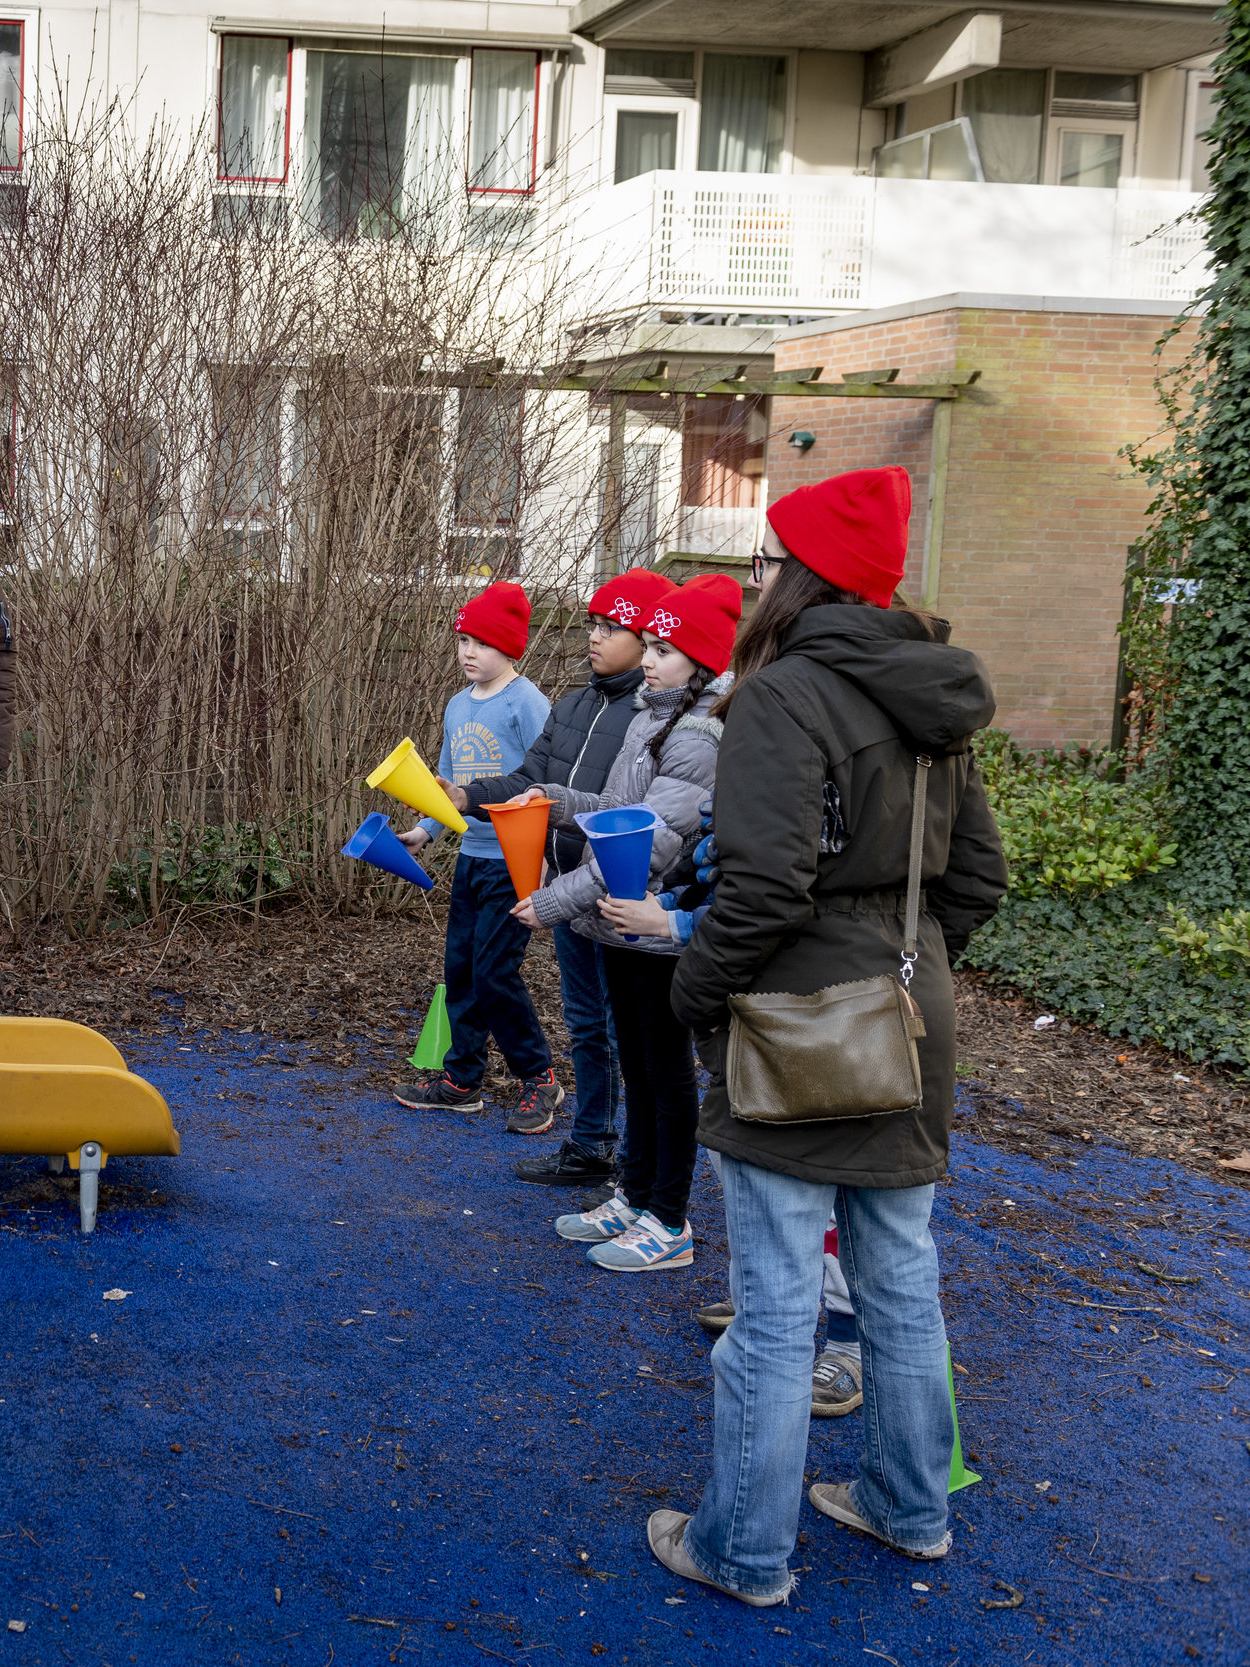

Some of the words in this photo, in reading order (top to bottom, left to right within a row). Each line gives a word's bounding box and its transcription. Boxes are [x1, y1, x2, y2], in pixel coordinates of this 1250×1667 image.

[464, 721, 503, 760] FLYWHEELS
[600, 1216, 628, 1235] N
[636, 1237, 665, 1259] N
